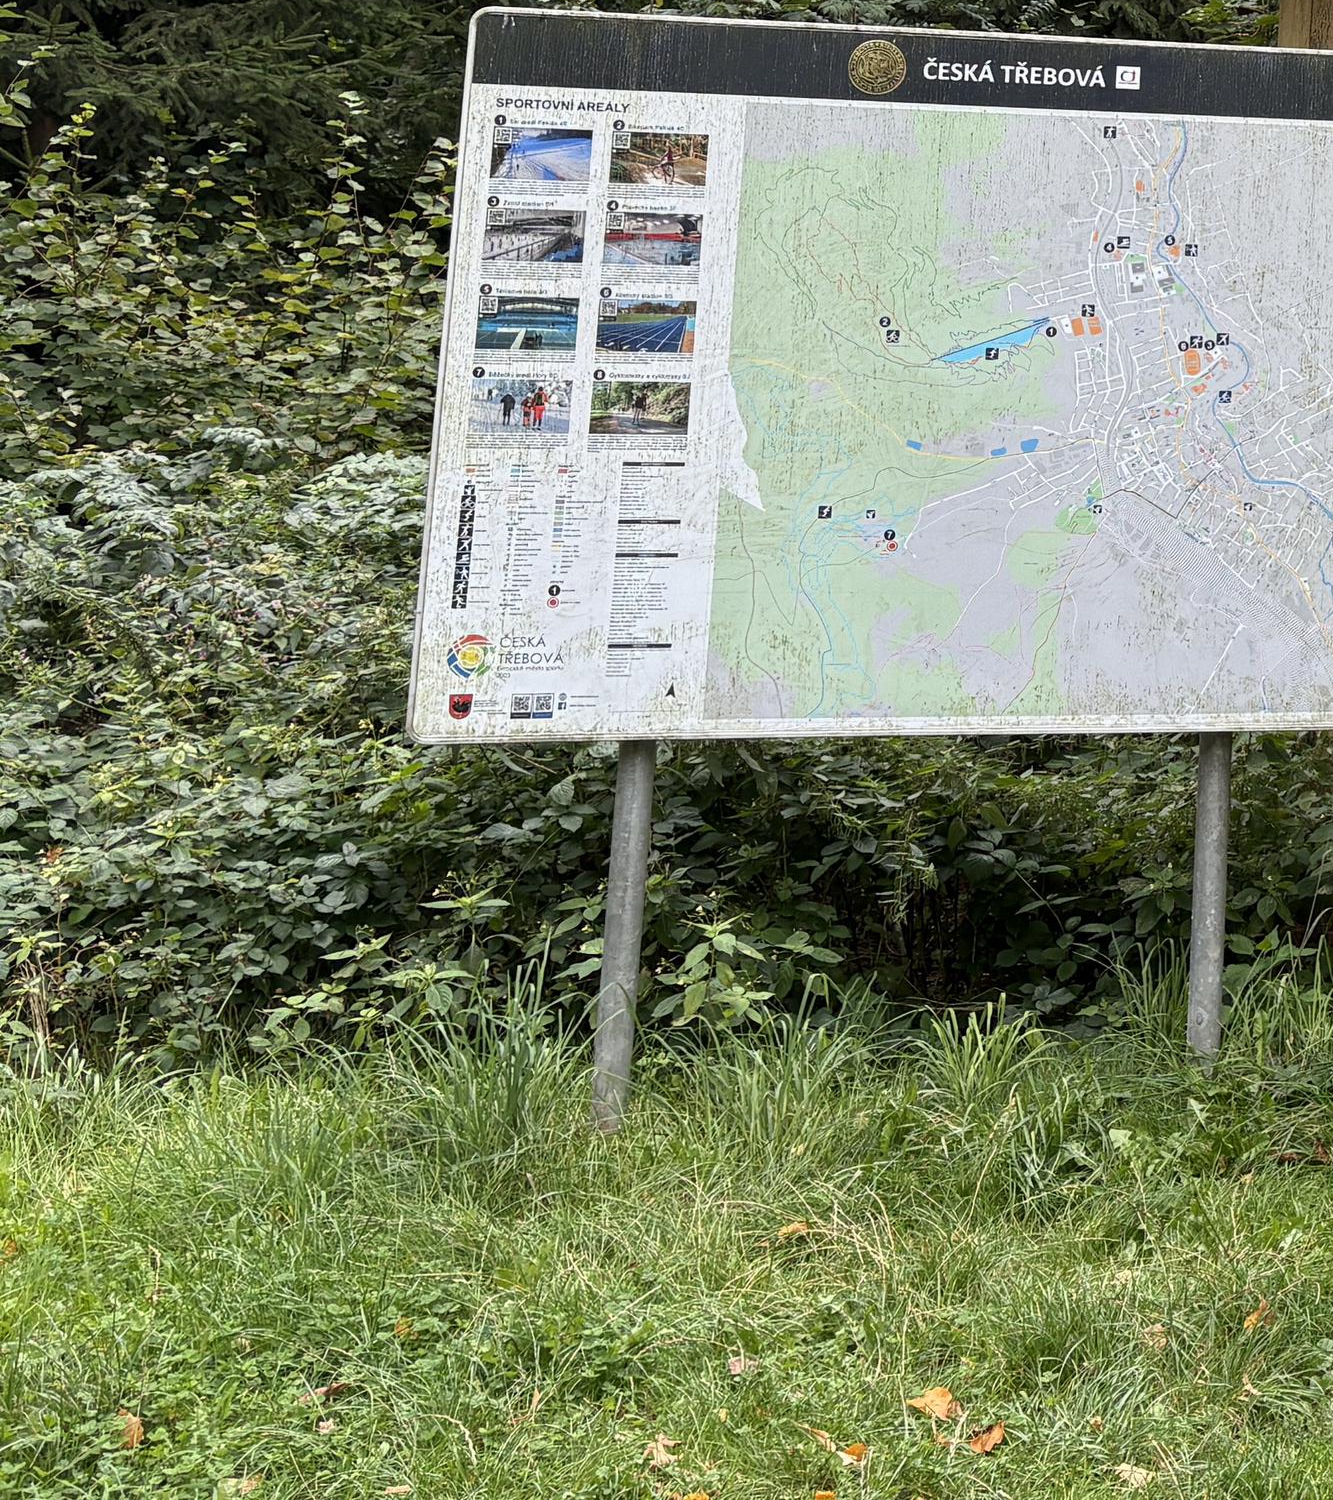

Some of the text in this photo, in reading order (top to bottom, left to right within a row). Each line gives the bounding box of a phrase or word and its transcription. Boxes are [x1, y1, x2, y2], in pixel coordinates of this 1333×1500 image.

[923, 57, 1106, 88] ČESKÁ TŘEBOVÁ
[496, 98, 630, 113] SPORTOVNÍ AREÁLY
[500, 633, 546, 648] ČESKÁ
[498, 648, 564, 665] TŘEBOVÁ
